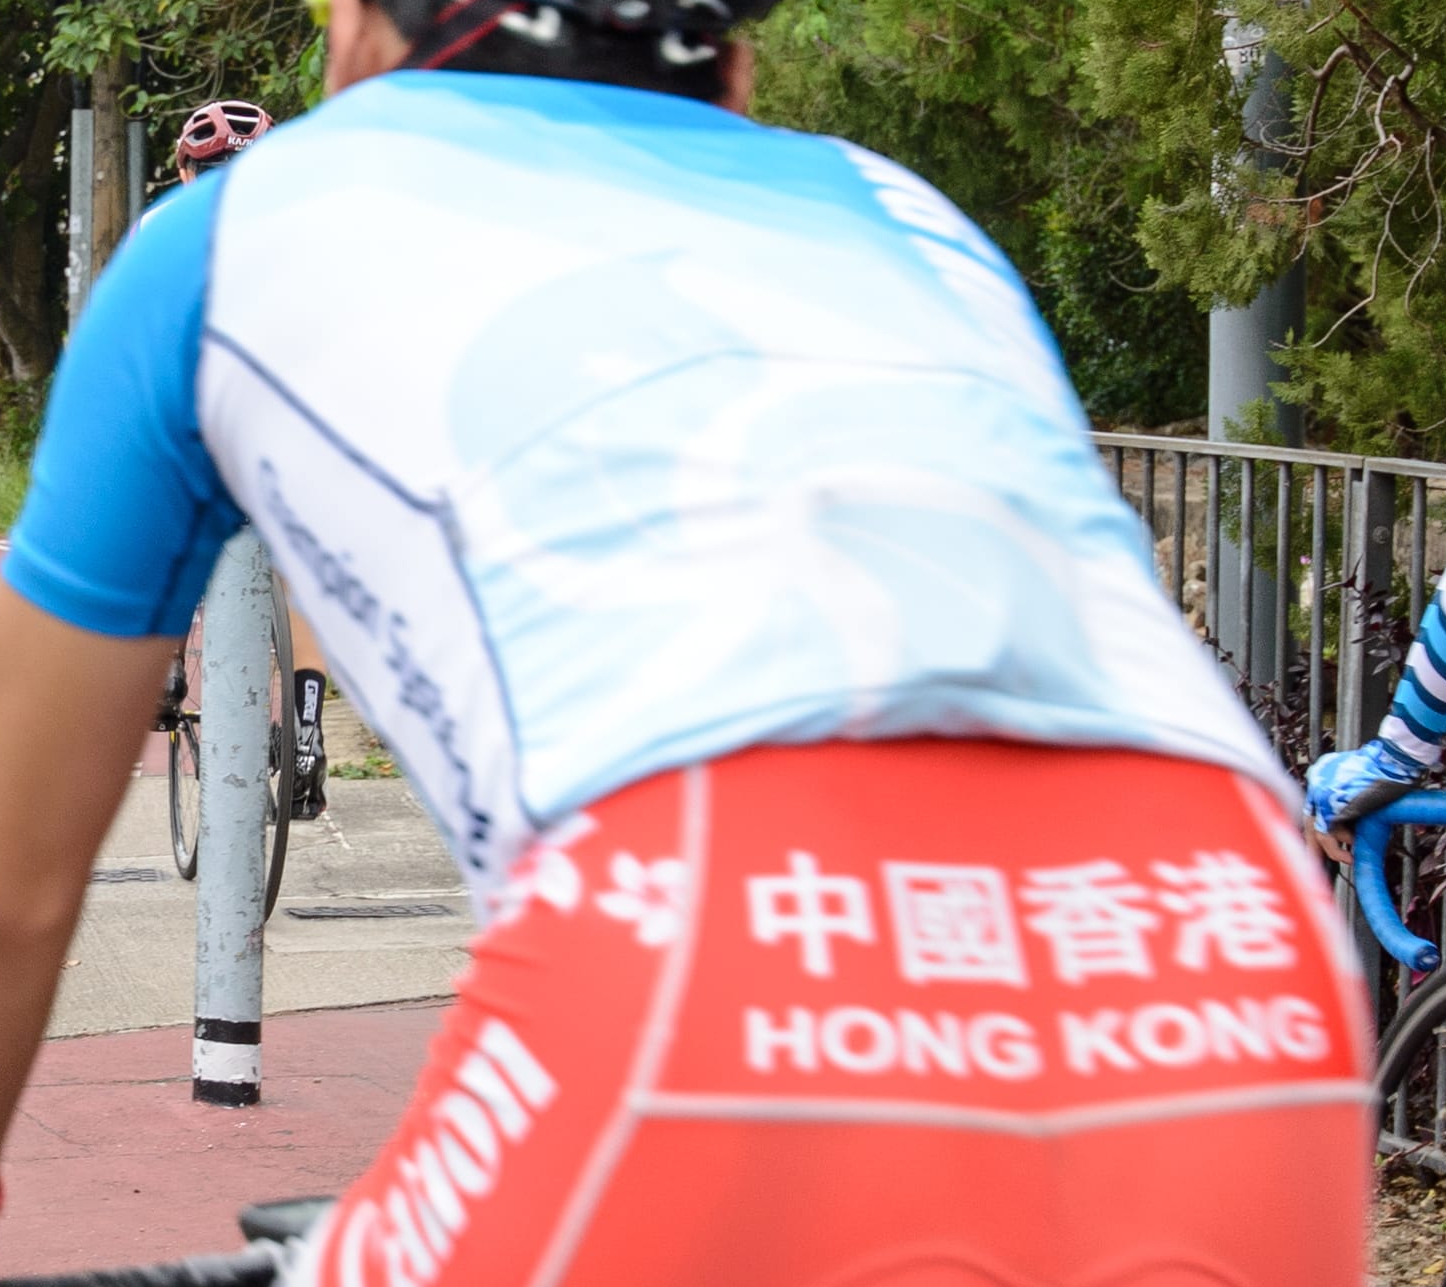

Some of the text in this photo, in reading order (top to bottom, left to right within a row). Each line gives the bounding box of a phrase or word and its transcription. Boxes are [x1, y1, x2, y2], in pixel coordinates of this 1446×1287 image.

[744, 848, 1300, 991] 中國香港
[744, 995, 1332, 1081] HONG KONG
